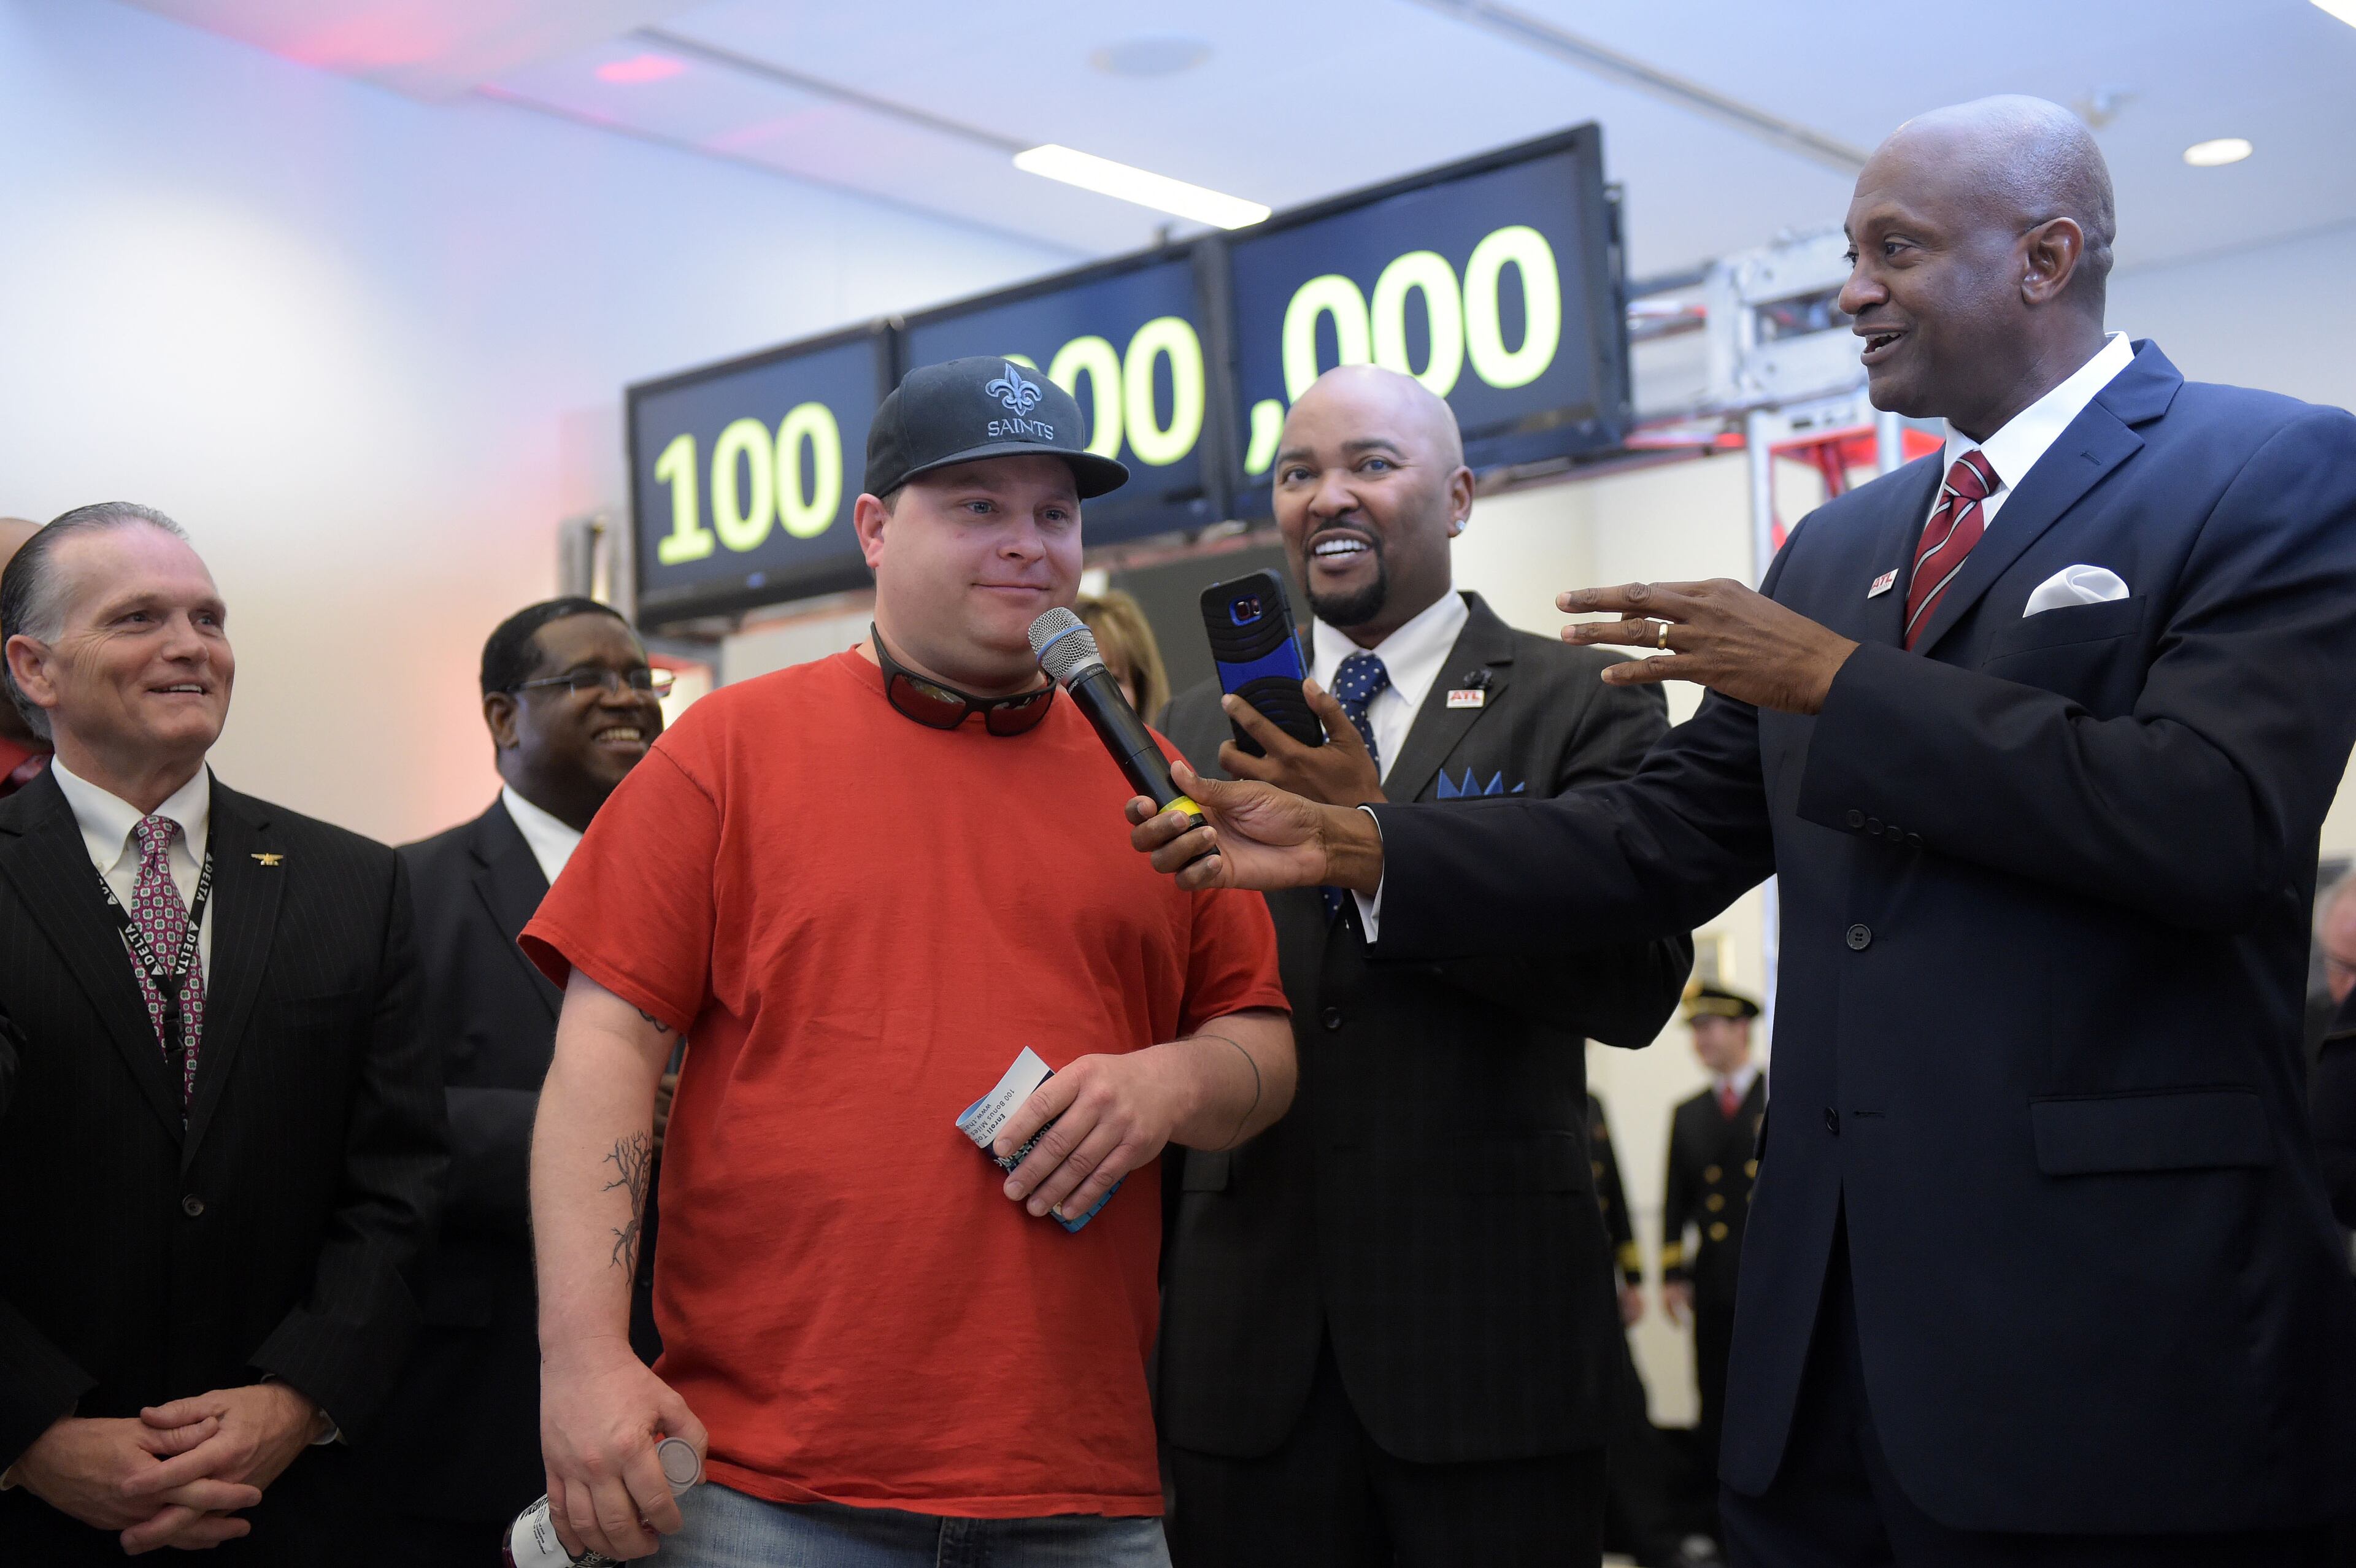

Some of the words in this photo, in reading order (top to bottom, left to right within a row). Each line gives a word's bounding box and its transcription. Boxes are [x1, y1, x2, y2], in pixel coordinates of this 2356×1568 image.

[987, 418, 1054, 440] SAINTS
[655, 403, 842, 564] 100
[1871, 572, 1893, 590] ATL
[1450, 691, 1480, 701] ATL
[196, 863, 214, 902] DELTA
[125, 923, 156, 966] DELTA
[175, 933, 197, 975] DELTA
[1004, 1089, 1015, 1101] 100
[987, 1101, 1006, 1121] Bonus
[971, 1120, 988, 1136] Miles
[987, 1113, 1006, 1134] Enroll
